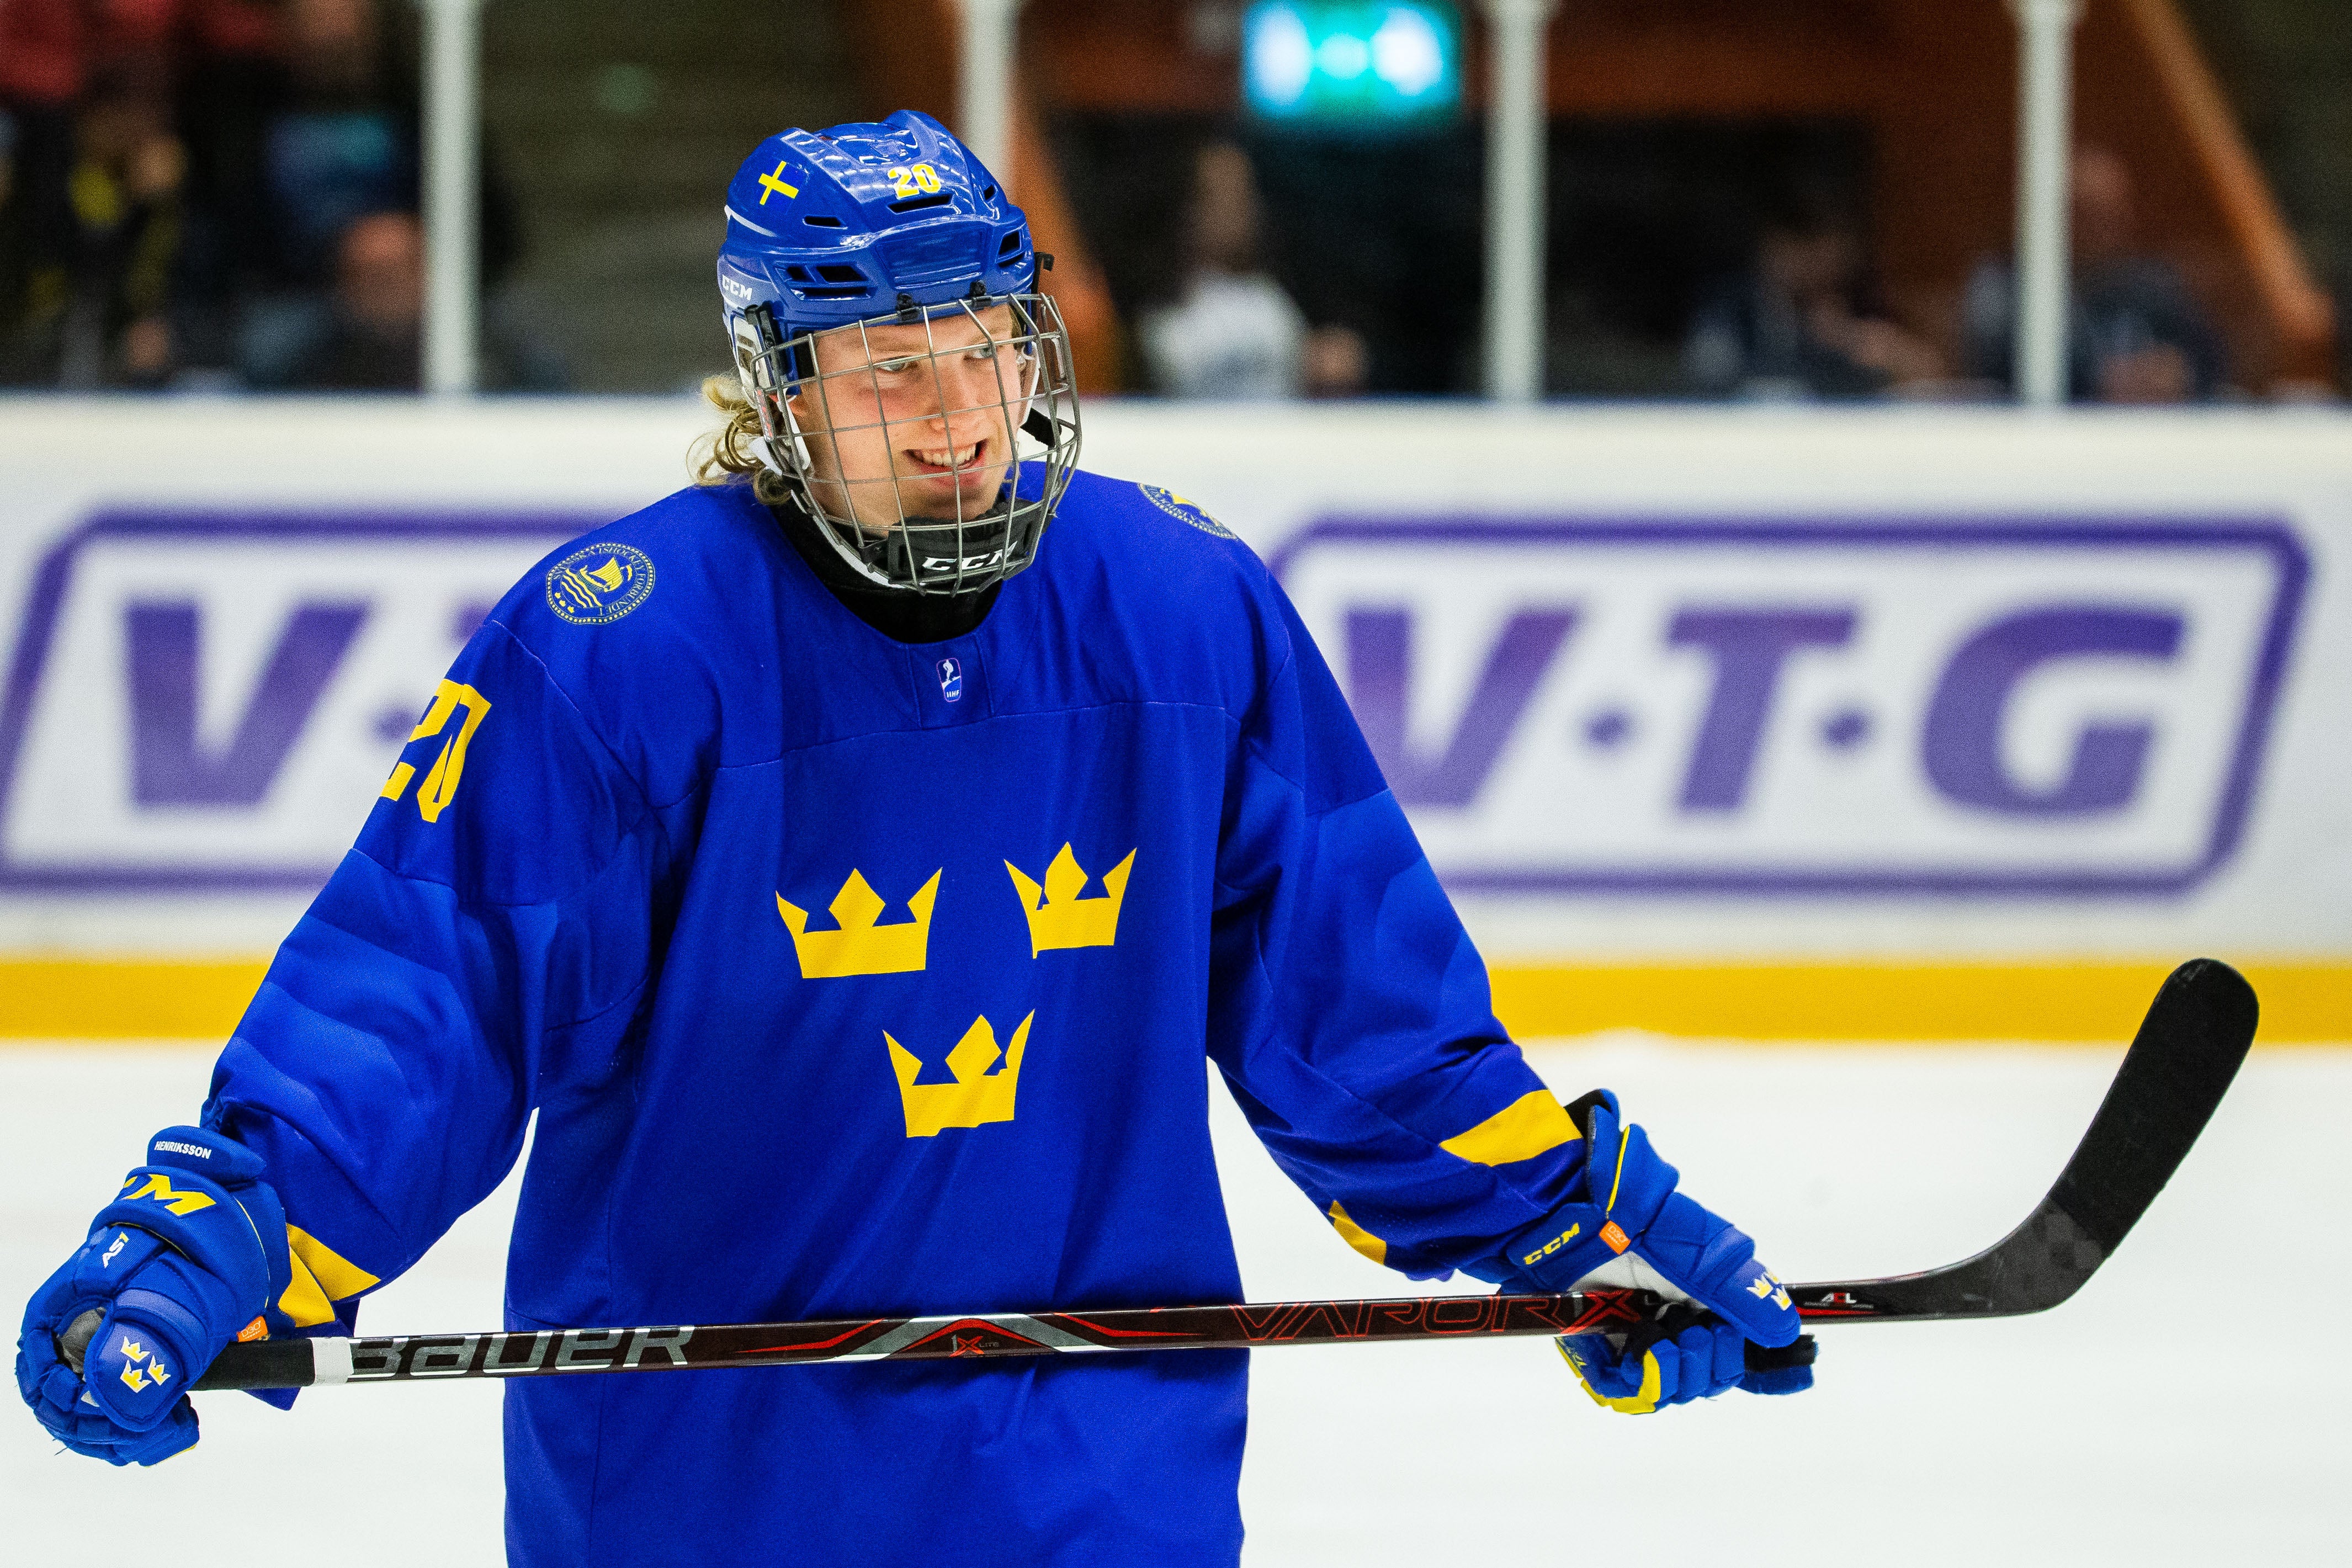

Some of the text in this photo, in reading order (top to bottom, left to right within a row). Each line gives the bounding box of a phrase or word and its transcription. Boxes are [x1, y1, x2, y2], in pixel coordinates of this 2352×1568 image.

[887, 163, 942, 200] 20
[723, 274, 753, 301] CCM
[155, 1141, 212, 1160] HENRIKSSON
[1523, 1222, 1580, 1264] CCM
[348, 1326, 695, 1378] BAUER
